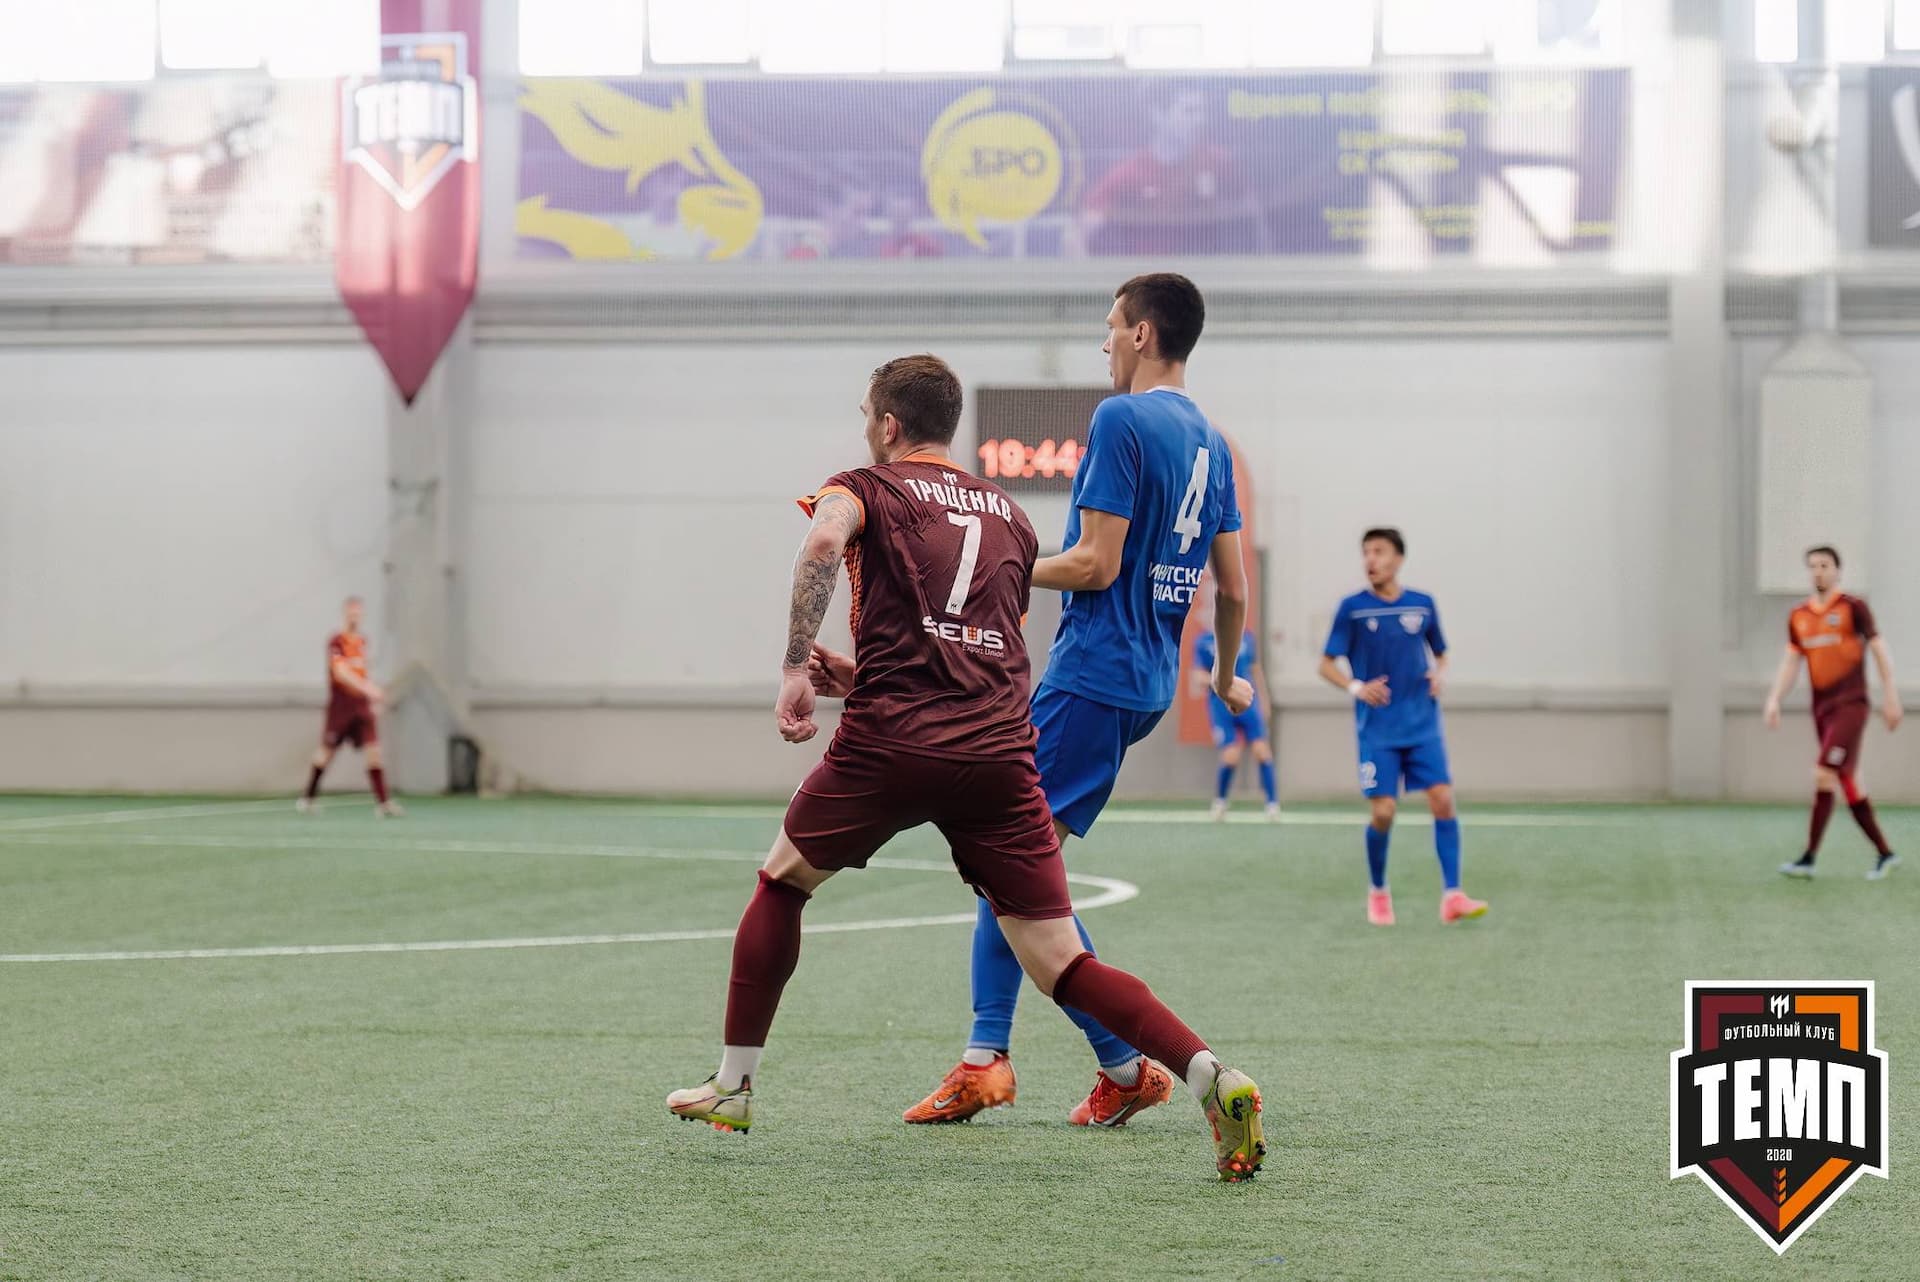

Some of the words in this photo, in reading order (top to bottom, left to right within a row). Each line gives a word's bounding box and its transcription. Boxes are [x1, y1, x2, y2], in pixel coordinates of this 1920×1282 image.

[904, 478, 1012, 523] ТРОЦЕНКО
[1173, 446, 1210, 555] 4
[945, 511, 982, 616] 7
[922, 615, 1004, 650] SEUS
